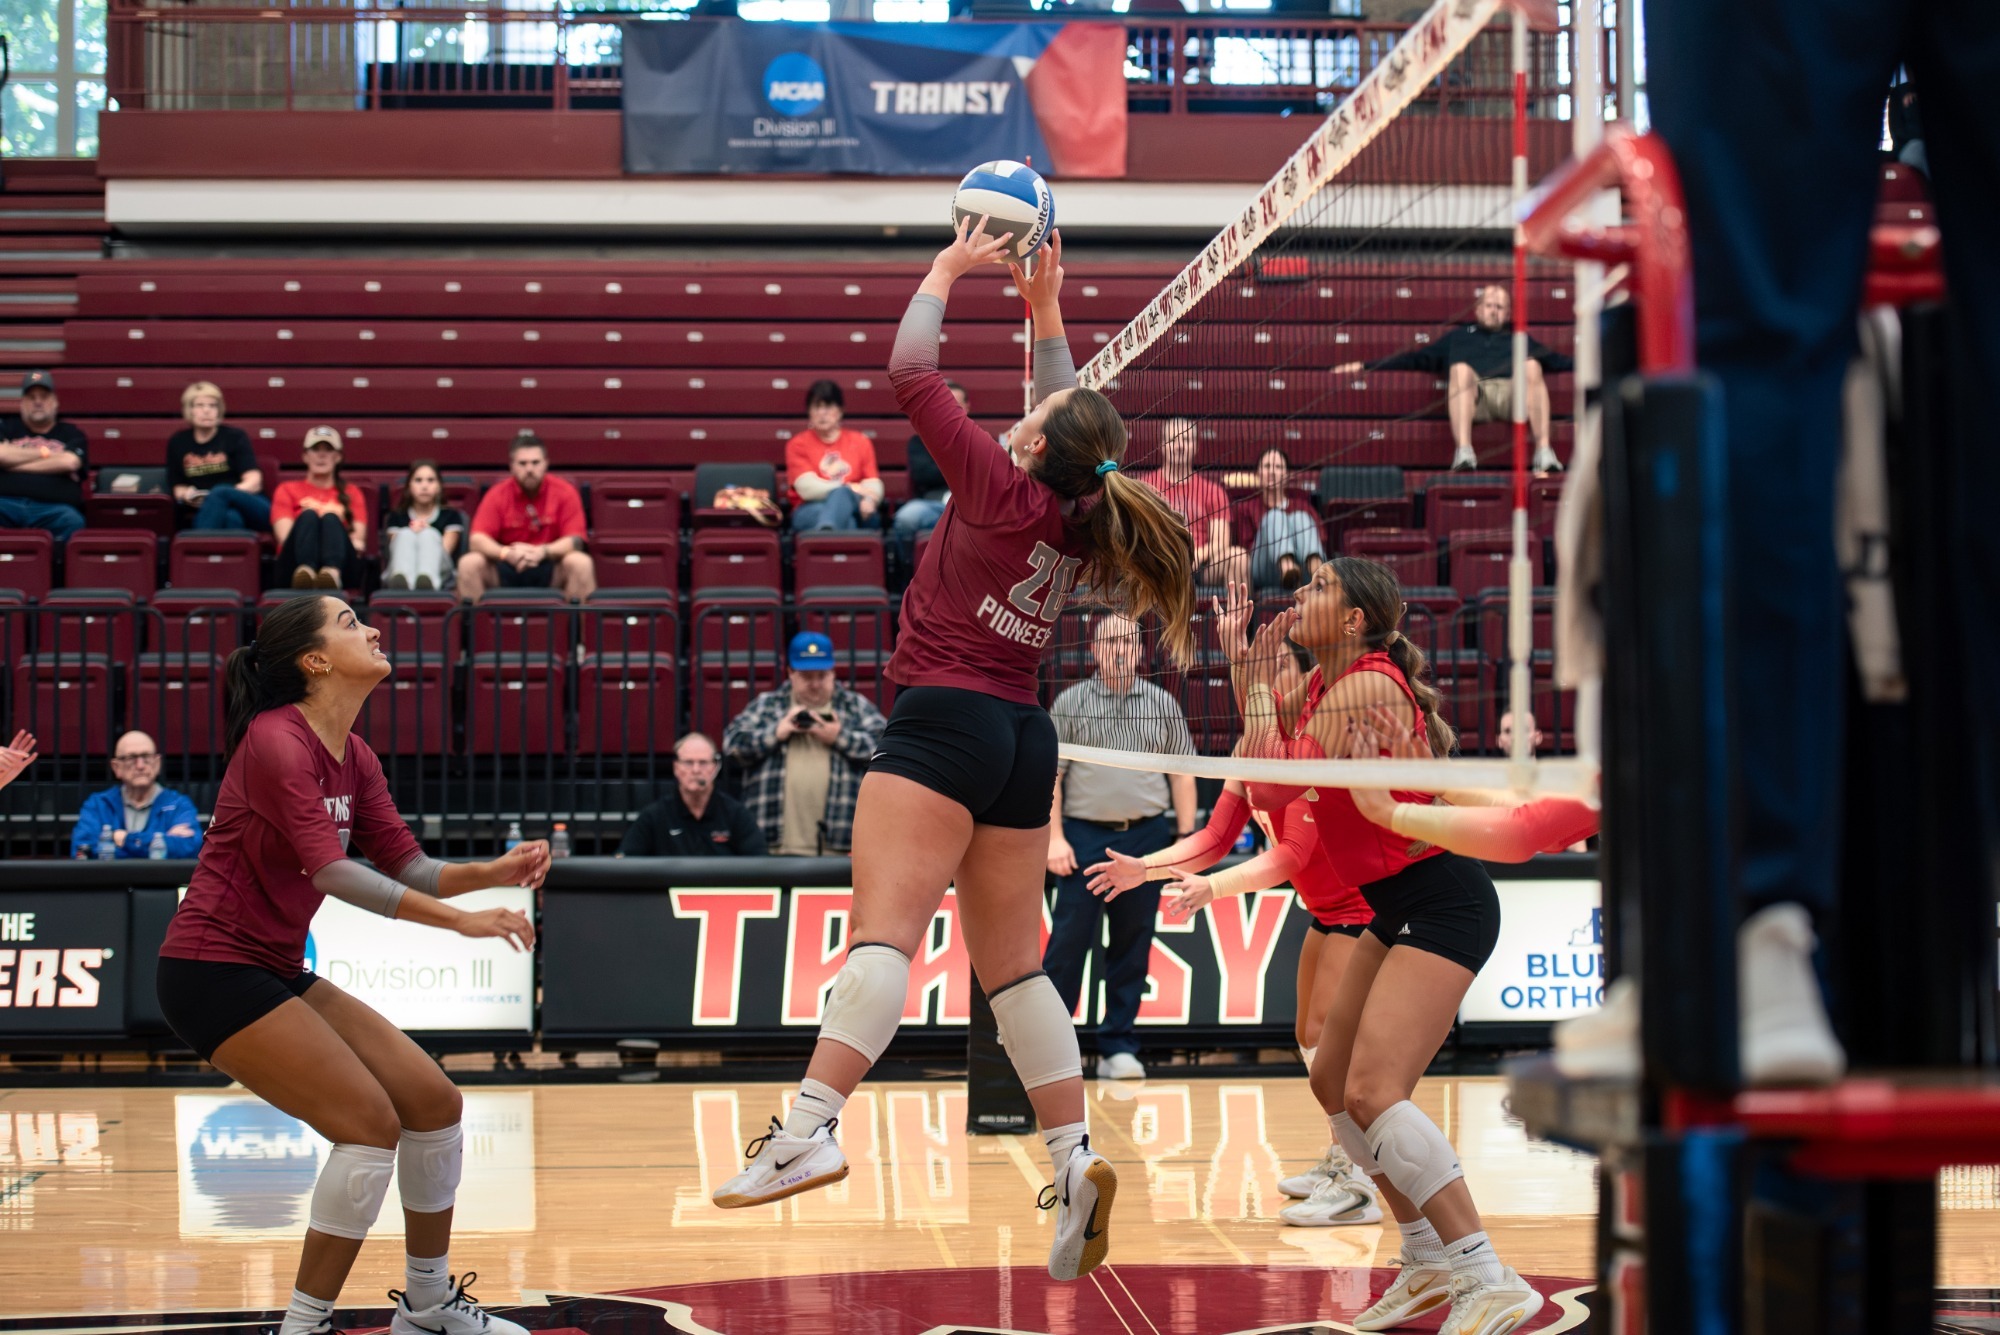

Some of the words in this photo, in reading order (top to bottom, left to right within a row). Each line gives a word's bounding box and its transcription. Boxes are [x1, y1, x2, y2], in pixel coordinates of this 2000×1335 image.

[769, 81, 826, 101] NCAA
[870, 80, 1012, 115] TRANSY
[753, 117, 820, 137] Division
[821, 118, 836, 136] III
[1027, 191, 1050, 247] molten
[1007, 540, 1082, 622] 20
[329, 959, 459, 991] Division
[471, 958, 493, 989] III
[461, 994, 522, 1004] DEDICATE
